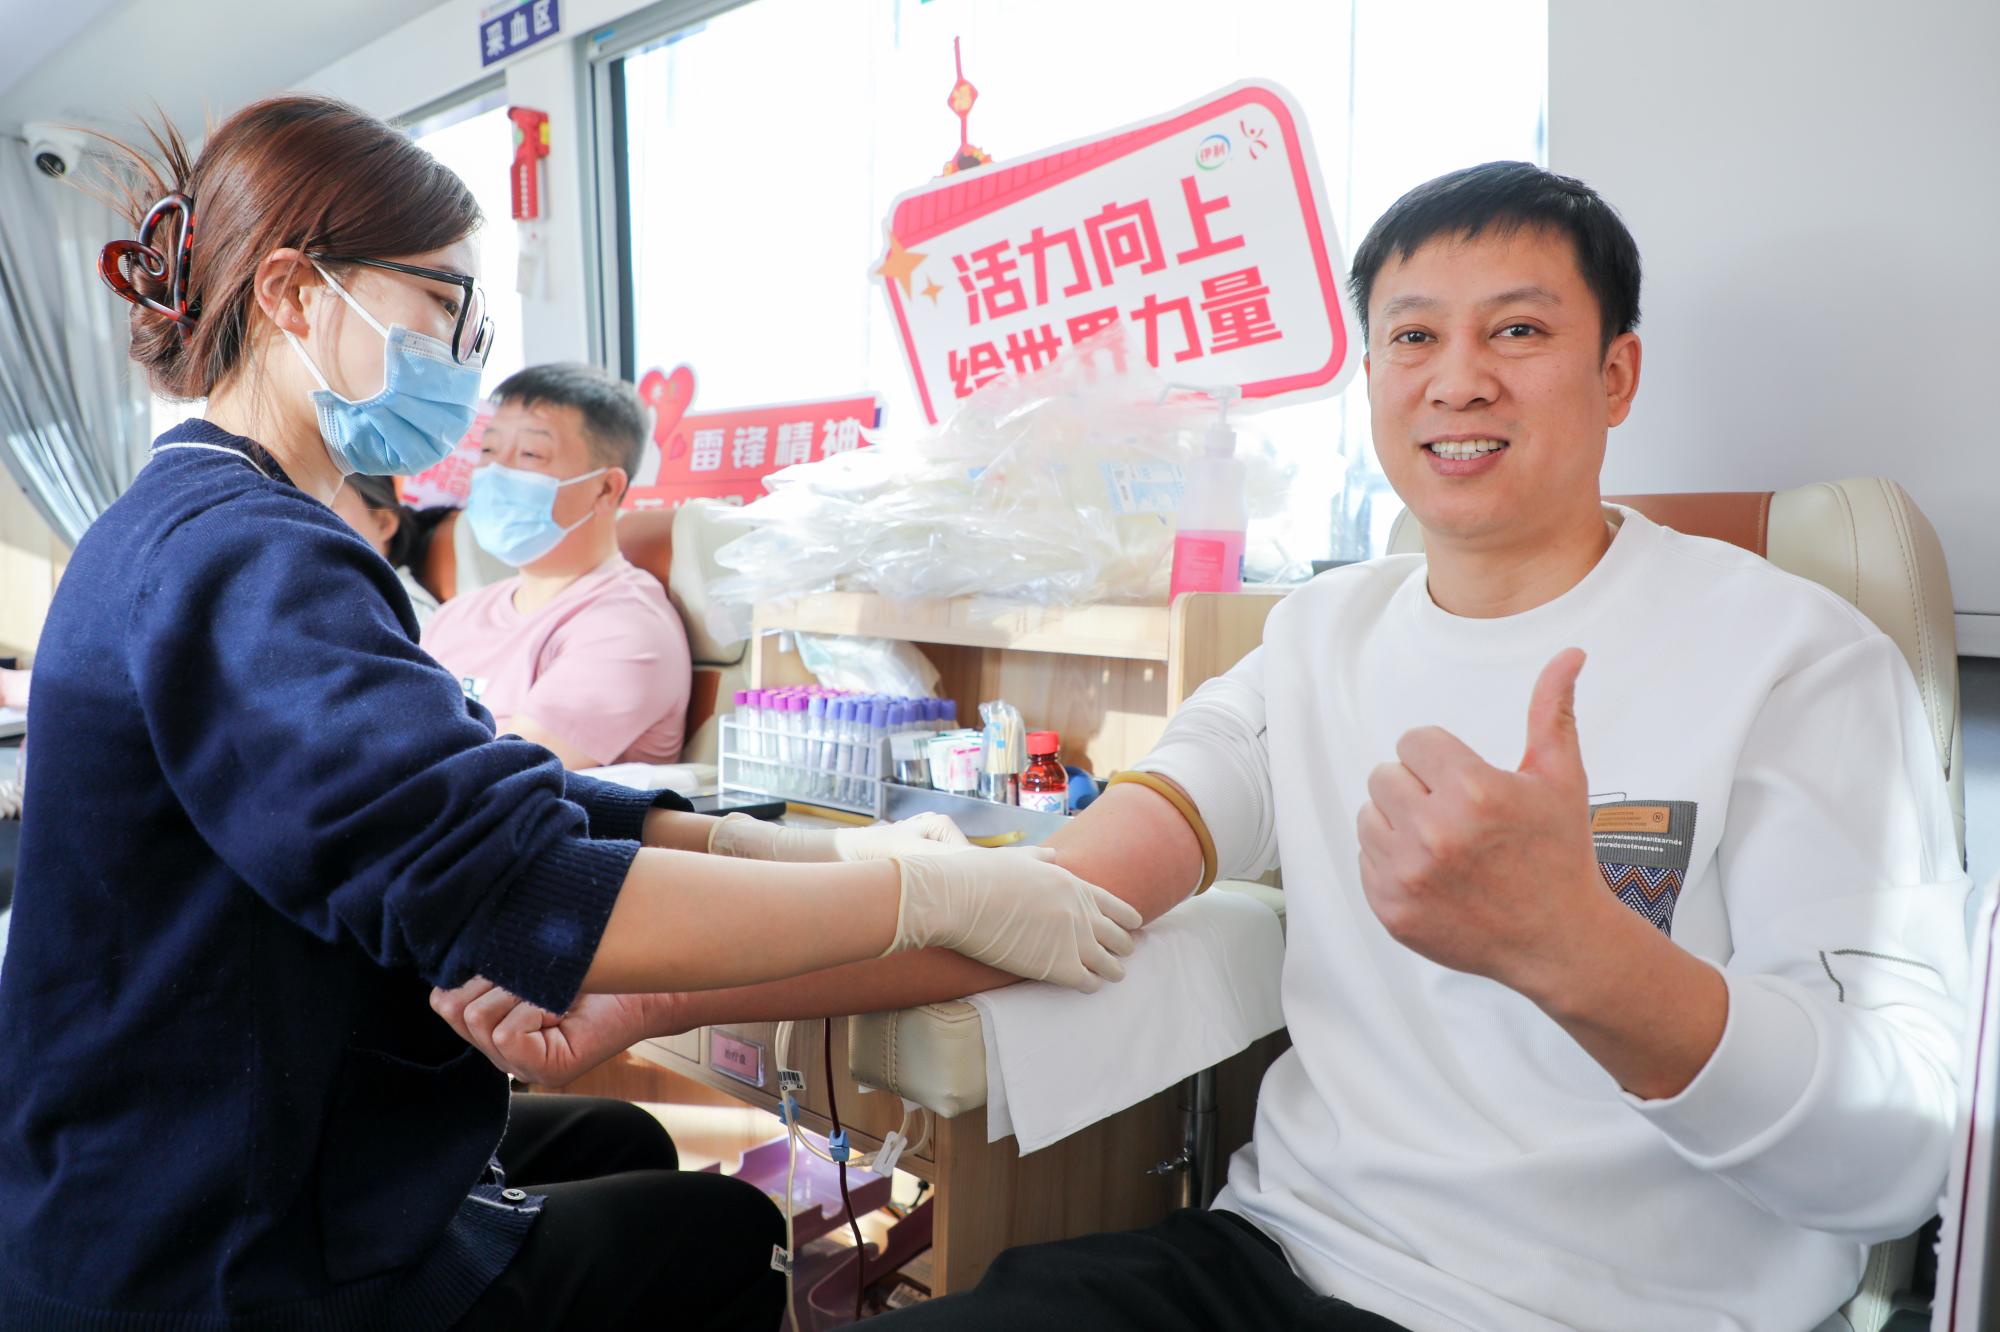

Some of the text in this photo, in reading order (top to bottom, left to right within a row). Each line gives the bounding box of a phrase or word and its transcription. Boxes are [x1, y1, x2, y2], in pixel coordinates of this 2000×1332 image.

[486, 0, 553, 57] 采血区
[951, 175, 1246, 326] 活力向上
[690, 417, 861, 472] 雷锋精神
